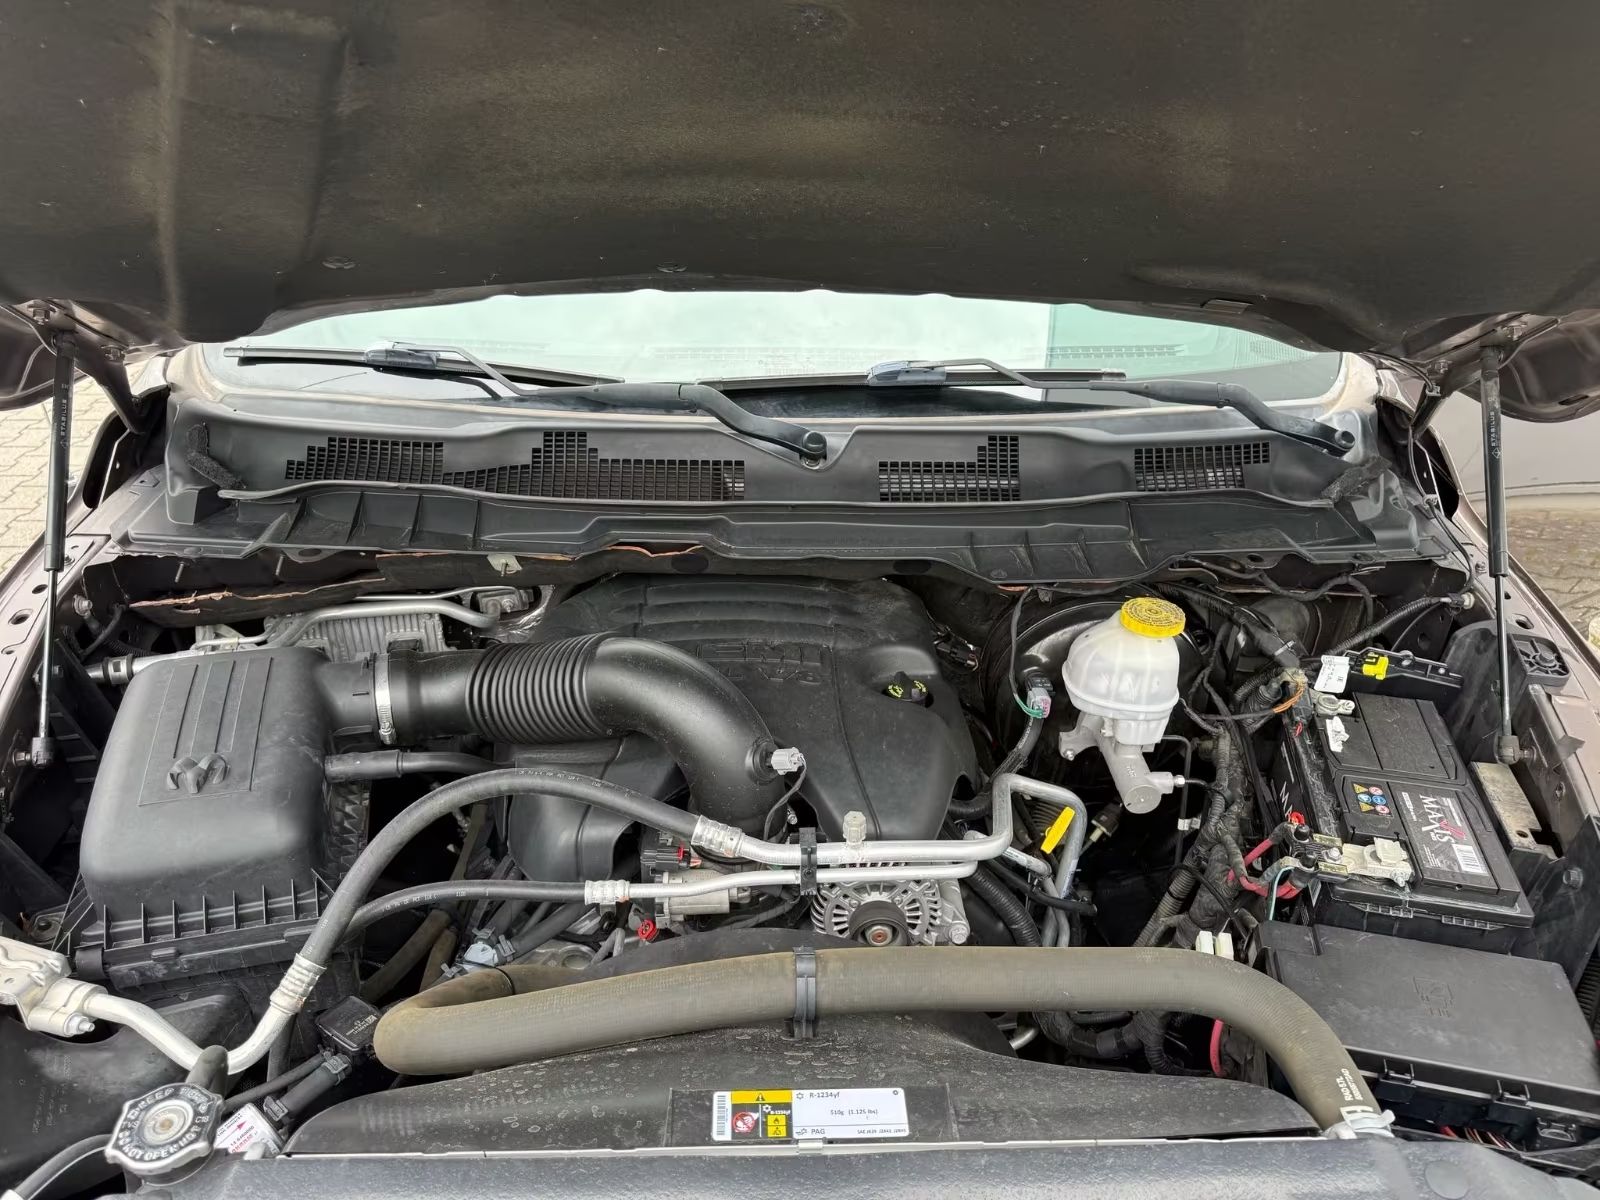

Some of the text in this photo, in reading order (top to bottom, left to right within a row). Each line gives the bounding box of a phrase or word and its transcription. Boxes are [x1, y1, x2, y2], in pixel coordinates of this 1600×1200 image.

[60, 399, 68, 437] STABILUS
[1489, 411, 1497, 447] STABILUS
[809, 1091, 841, 1099] R-1234yf
[144, 1143, 180, 1161] OPEN
